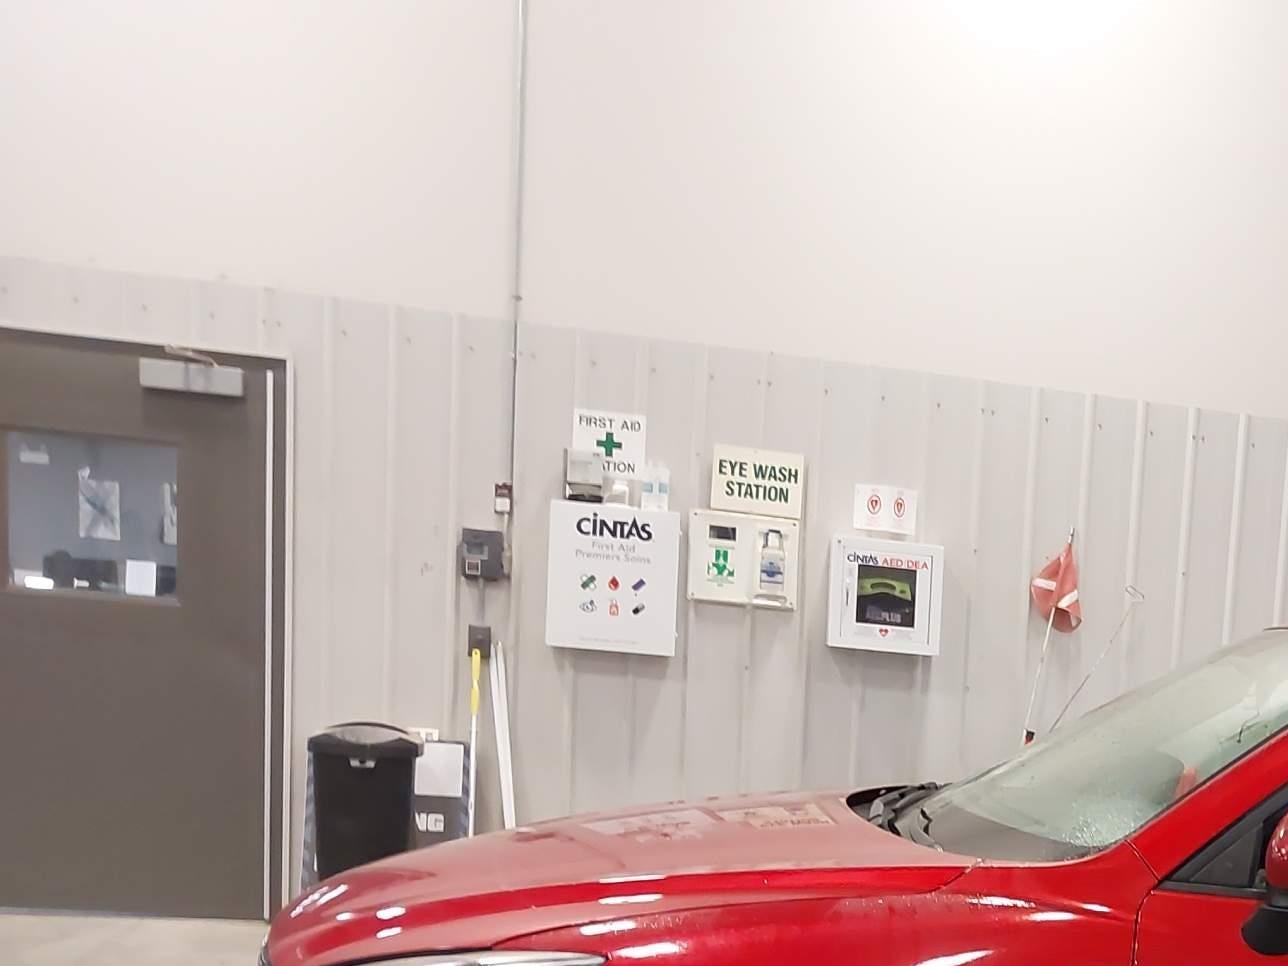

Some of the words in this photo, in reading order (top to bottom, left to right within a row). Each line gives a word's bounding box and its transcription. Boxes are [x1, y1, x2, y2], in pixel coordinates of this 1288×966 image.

[579, 415, 615, 429] FIRST
[621, 420, 641, 432] AID
[602, 461, 636, 473] TION
[719, 459, 748, 478] EYE
[753, 463, 799, 484] WASH
[725, 480, 790, 503] STATION
[618, 543, 636, 553] Aid
